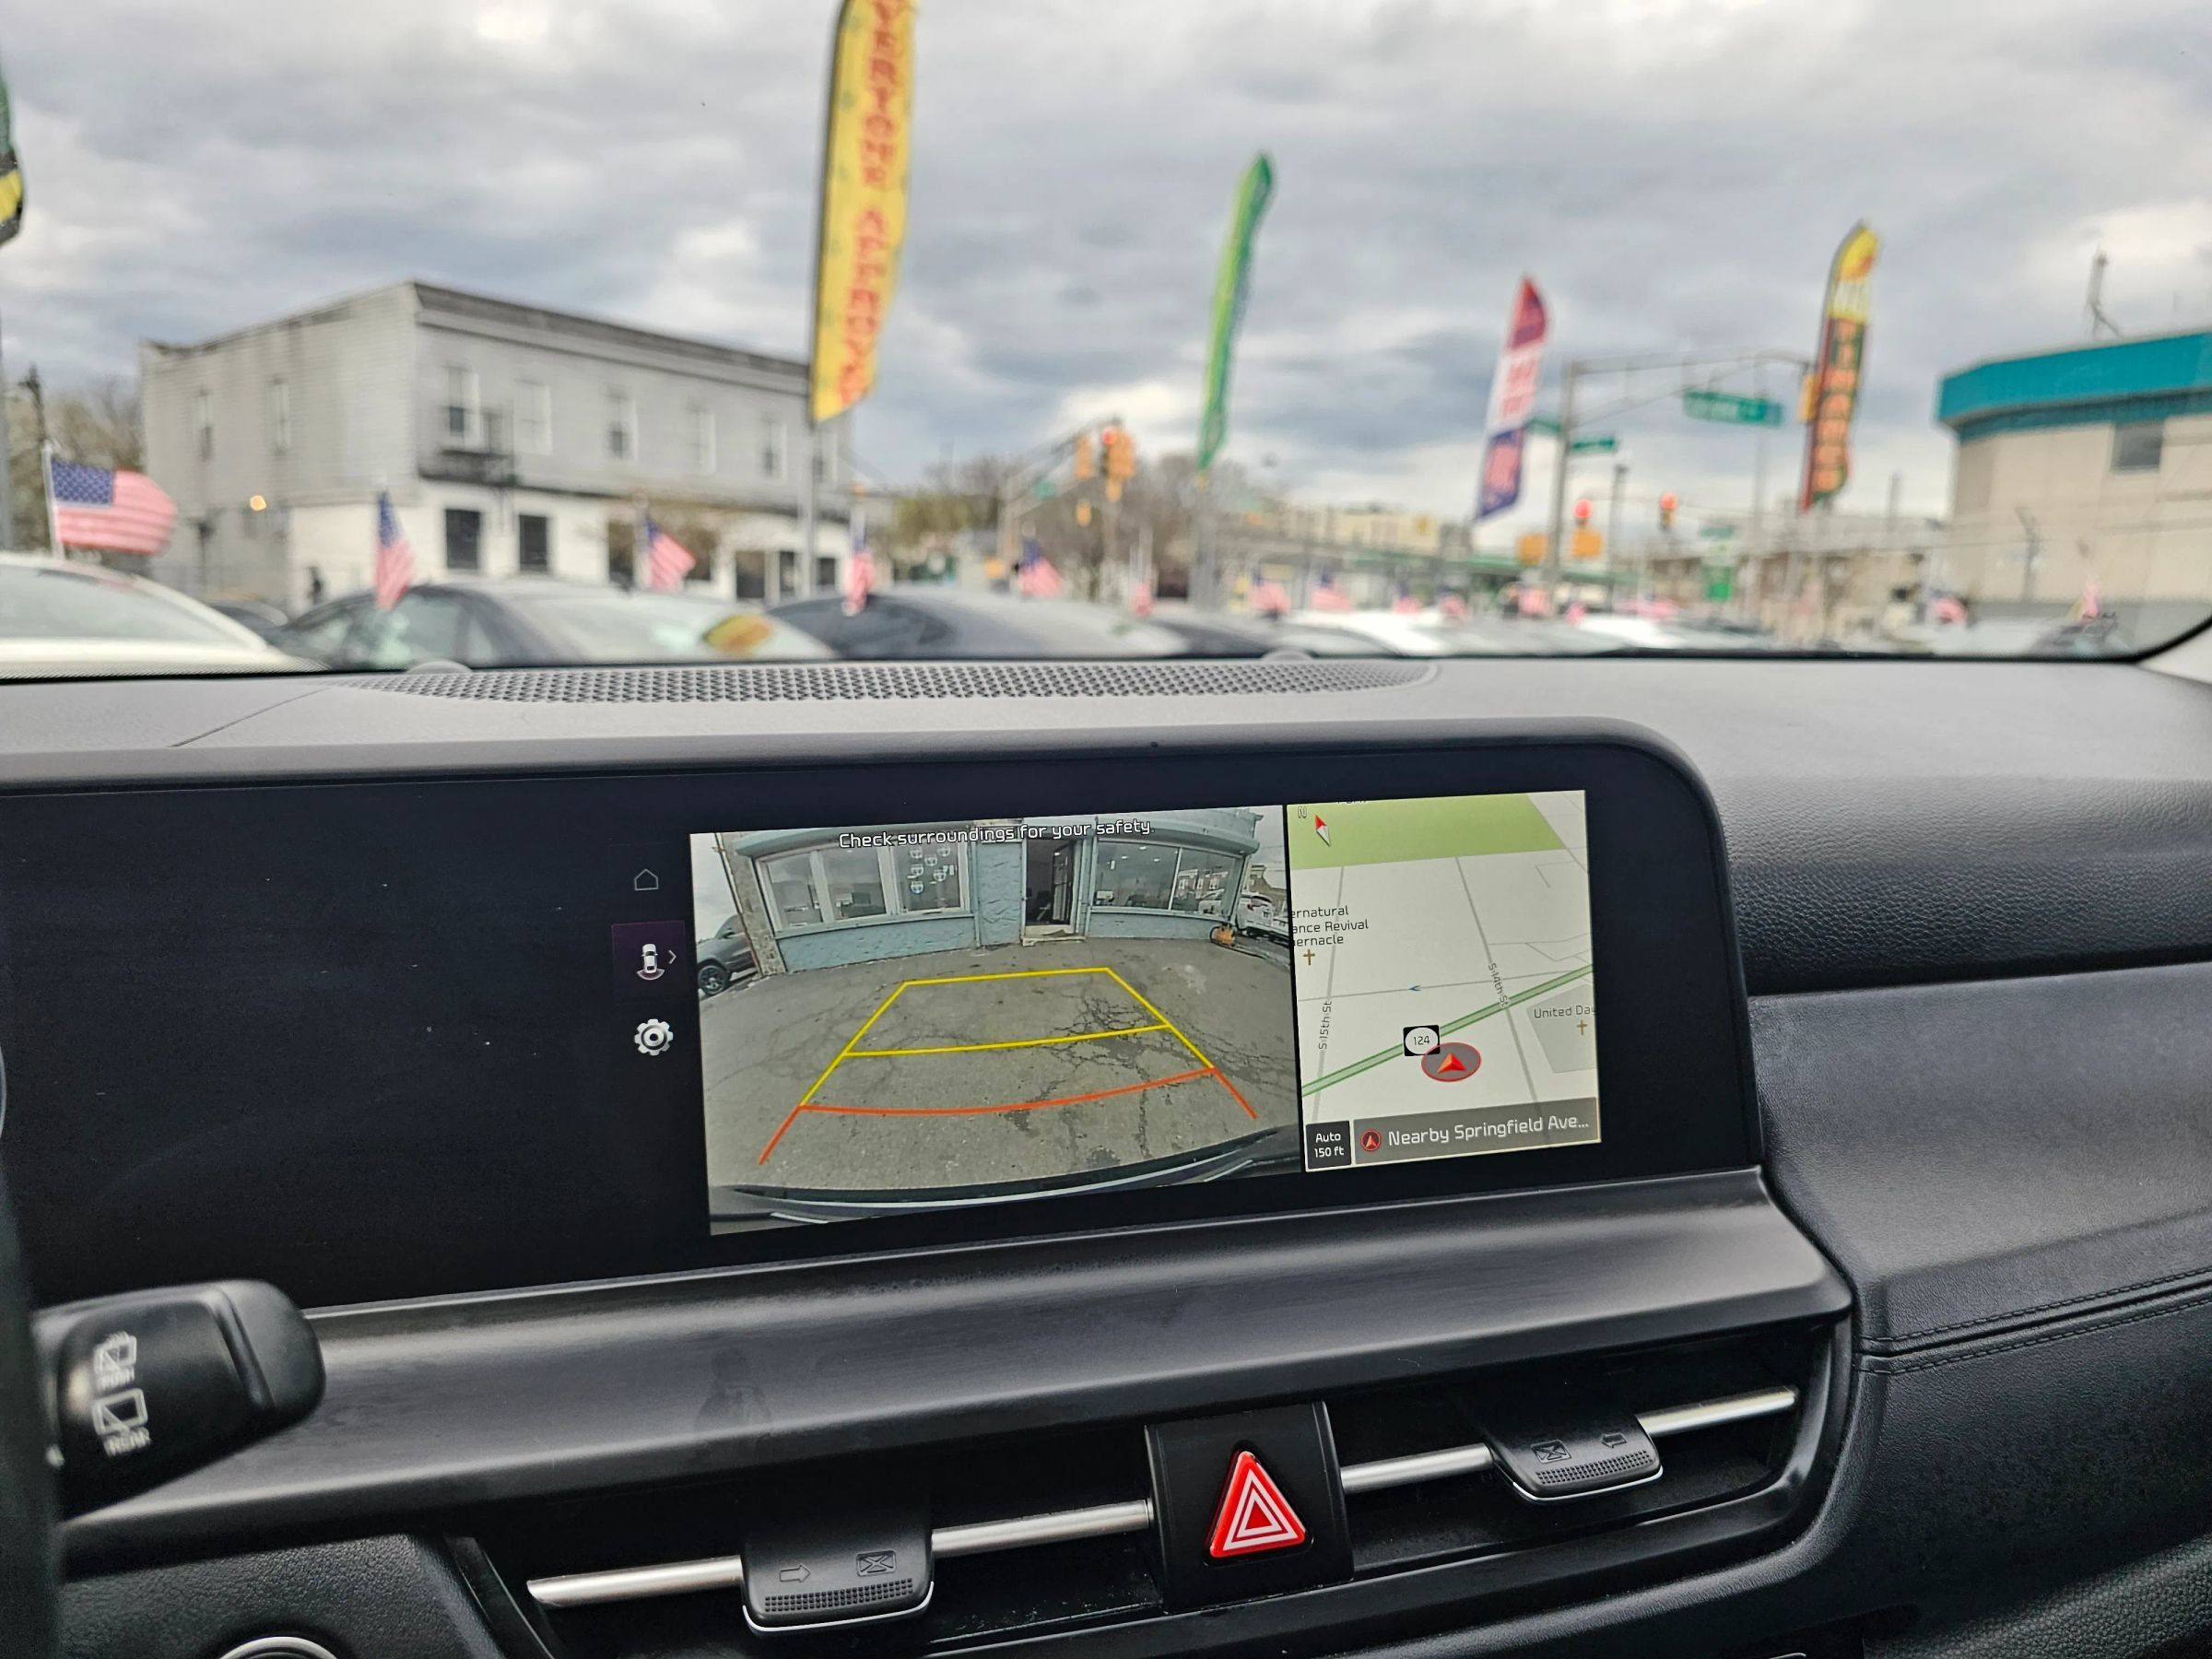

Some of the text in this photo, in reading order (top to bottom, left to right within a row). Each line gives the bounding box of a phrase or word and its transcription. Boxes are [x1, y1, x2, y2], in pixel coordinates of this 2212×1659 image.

[839, 818, 1155, 848] Check surroundings for your safety.
[1324, 919, 1370, 932] Revival
[1488, 962, 1509, 1007] S 14th St
[1322, 1001, 1332, 1013] St
[1534, 1006, 1572, 1018] United
[1319, 1017, 1331, 1039] 15th
[1413, 1035, 1430, 1046] 124
[1388, 1114, 1589, 1146] Nearby Springfield Ave...
[1315, 1132, 1341, 1143] Auto
[1314, 1146, 1345, 1158] 150 ft
